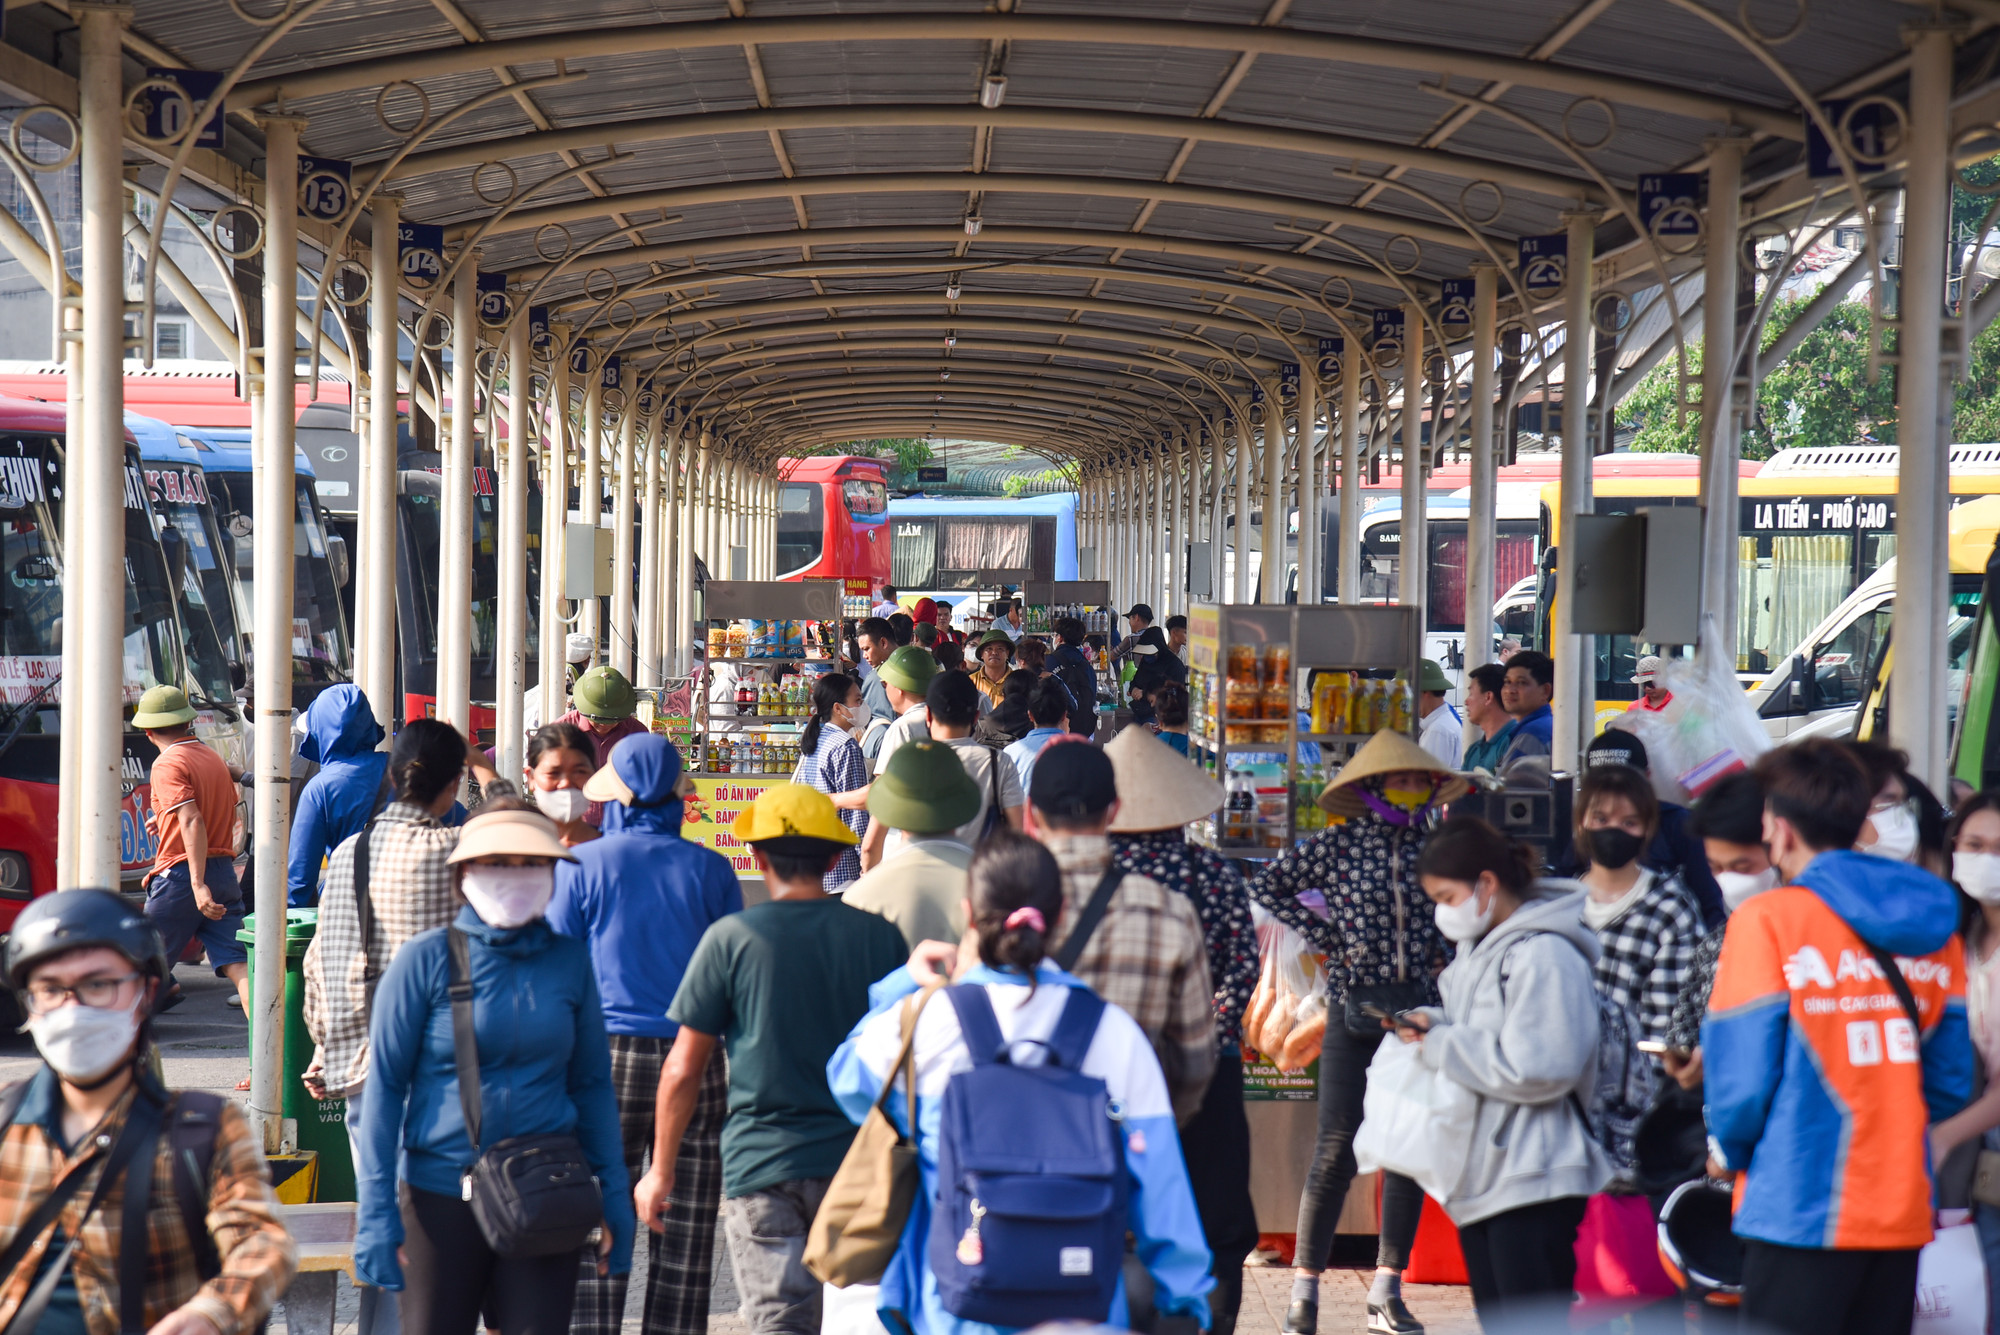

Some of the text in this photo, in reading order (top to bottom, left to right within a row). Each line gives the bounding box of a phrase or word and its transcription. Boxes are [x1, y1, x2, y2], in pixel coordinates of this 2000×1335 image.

[1642, 177, 1662, 192] A1
[1649, 196, 1695, 229] 22
[1522, 240, 1538, 253] A1
[401, 246, 440, 275] 04
[1444, 282, 1459, 293] A1
[1376, 311, 1389, 322] A1
[1320, 340, 1332, 349] A1
[1283, 366, 1294, 374] A1
[1755, 504, 1773, 528] LA
[1777, 496, 1809, 529] TIẾN
[1822, 496, 1856, 528] PHỐ
[1856, 503, 1887, 528] CAO
[898, 522, 922, 536] LÂM
[847, 578, 868, 589] HÀNG
[731, 784, 743, 801] ĂN
[732, 857, 752, 870] TÔM
[318, 1099, 341, 1111] HÃY
[319, 1111, 342, 1122] VÀO
